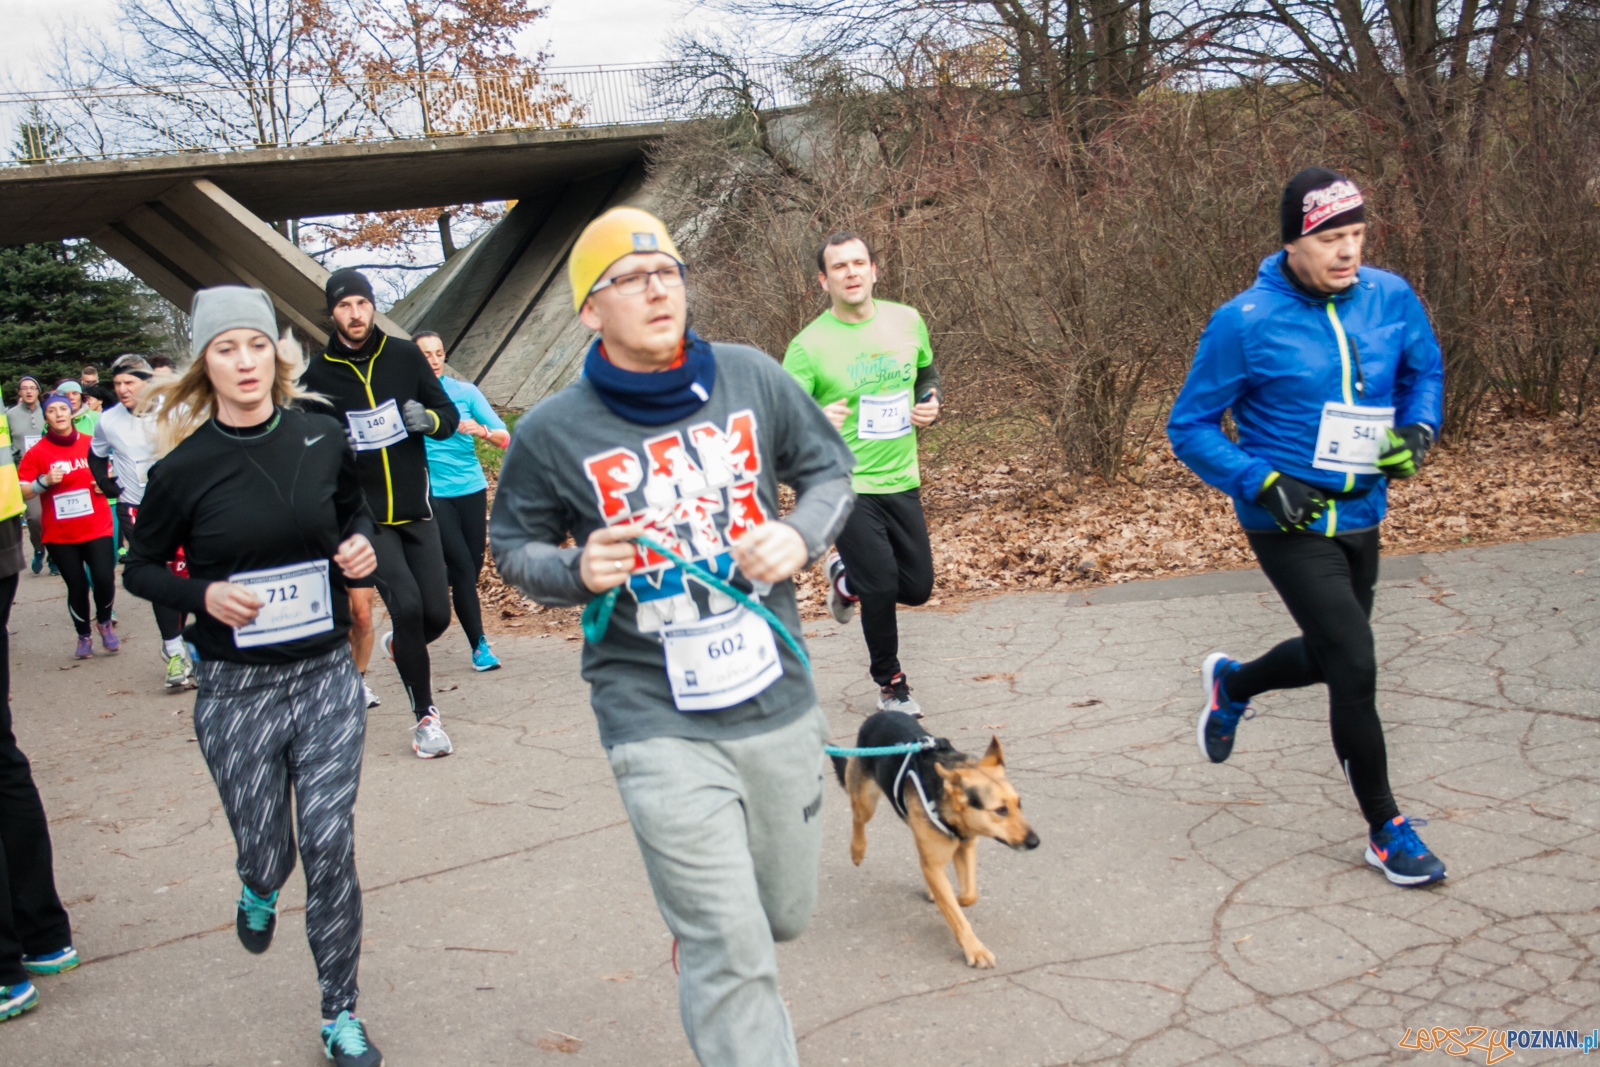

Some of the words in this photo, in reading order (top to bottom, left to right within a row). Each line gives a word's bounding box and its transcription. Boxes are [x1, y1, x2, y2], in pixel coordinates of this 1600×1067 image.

[902, 363, 912, 382] 3
[881, 407, 899, 418] 721
[366, 416, 386, 429] 140
[1352, 426, 1376, 440] 541
[266, 584, 299, 603] 712
[708, 633, 746, 659] 602
